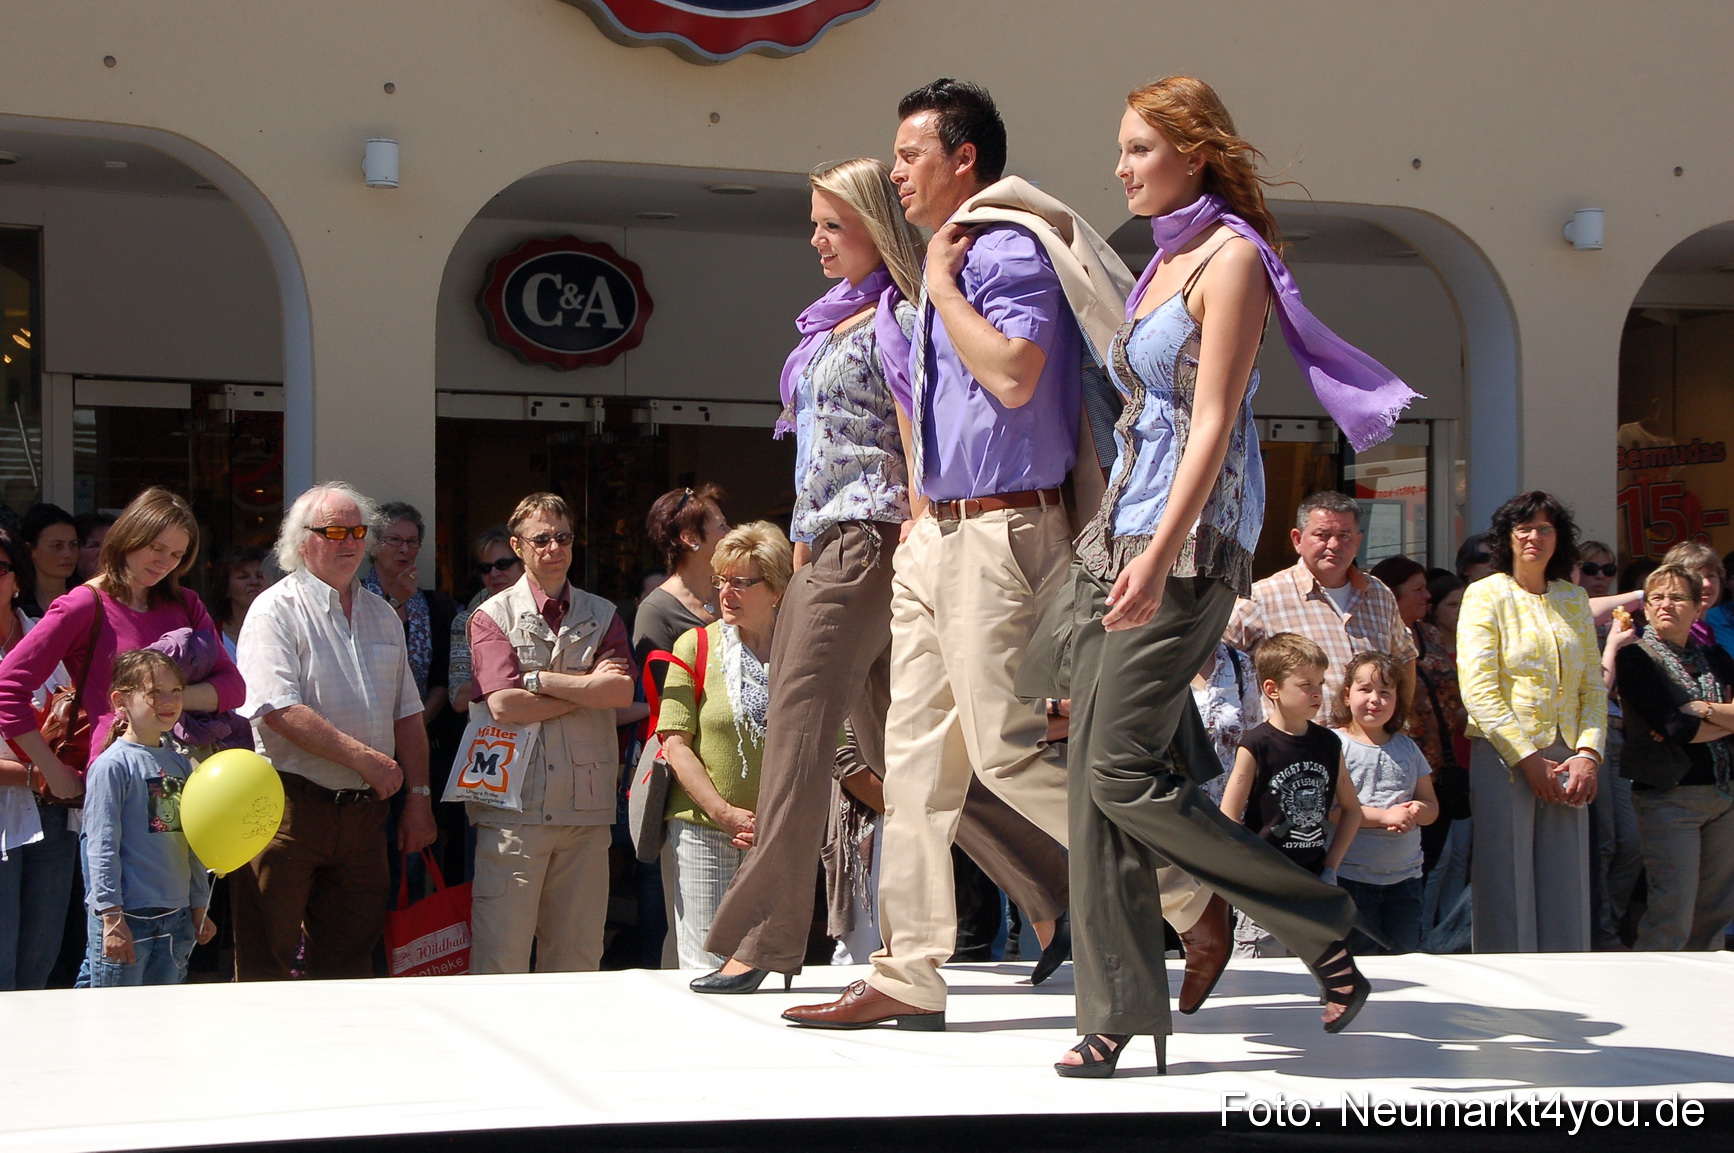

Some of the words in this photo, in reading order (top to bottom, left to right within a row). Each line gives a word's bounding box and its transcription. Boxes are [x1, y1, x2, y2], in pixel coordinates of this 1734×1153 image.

[522, 272, 625, 329] C&A
[1617, 438, 1728, 470] Bermudas
[415, 932, 466, 959] Wildbad
[408, 957, 465, 977] otheke
